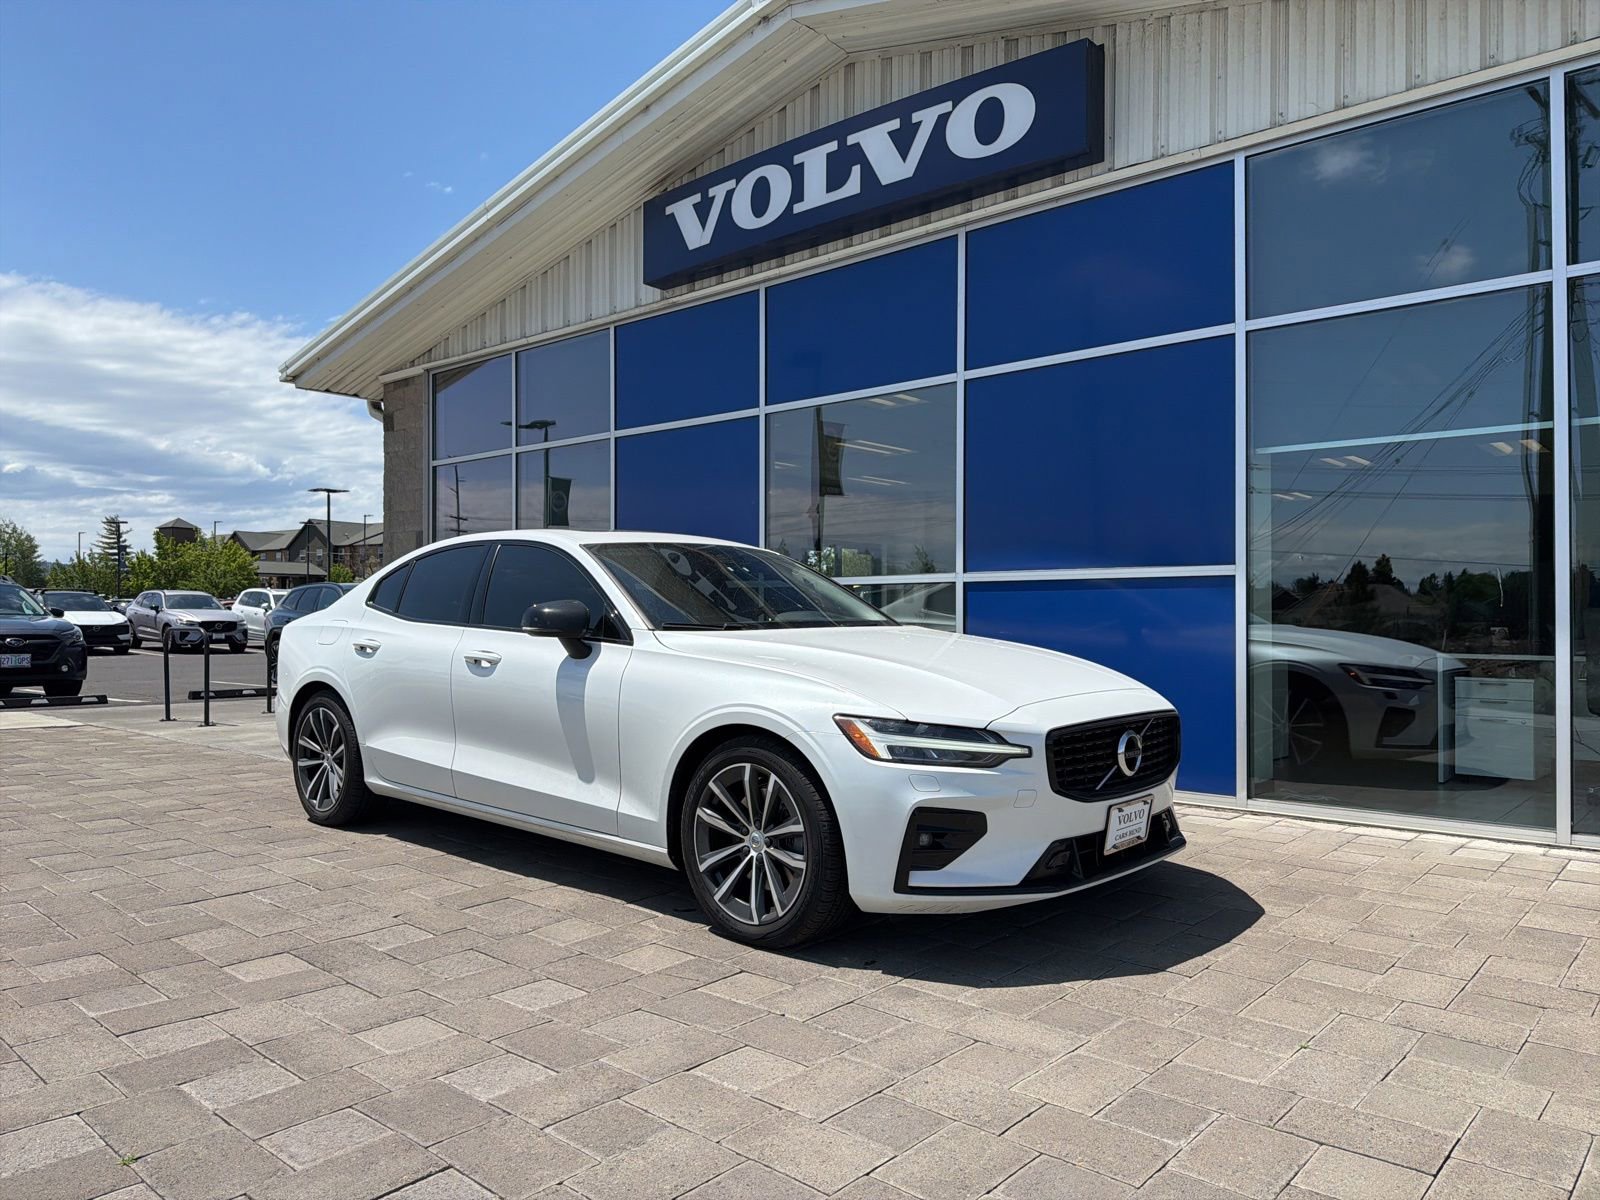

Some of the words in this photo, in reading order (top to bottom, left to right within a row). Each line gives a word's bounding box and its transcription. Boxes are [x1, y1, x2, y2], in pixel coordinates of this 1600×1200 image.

[665, 82, 1036, 250] VOLVO
[1118, 808, 1145, 825] VOLVO
[1114, 831, 1128, 841] CARS
